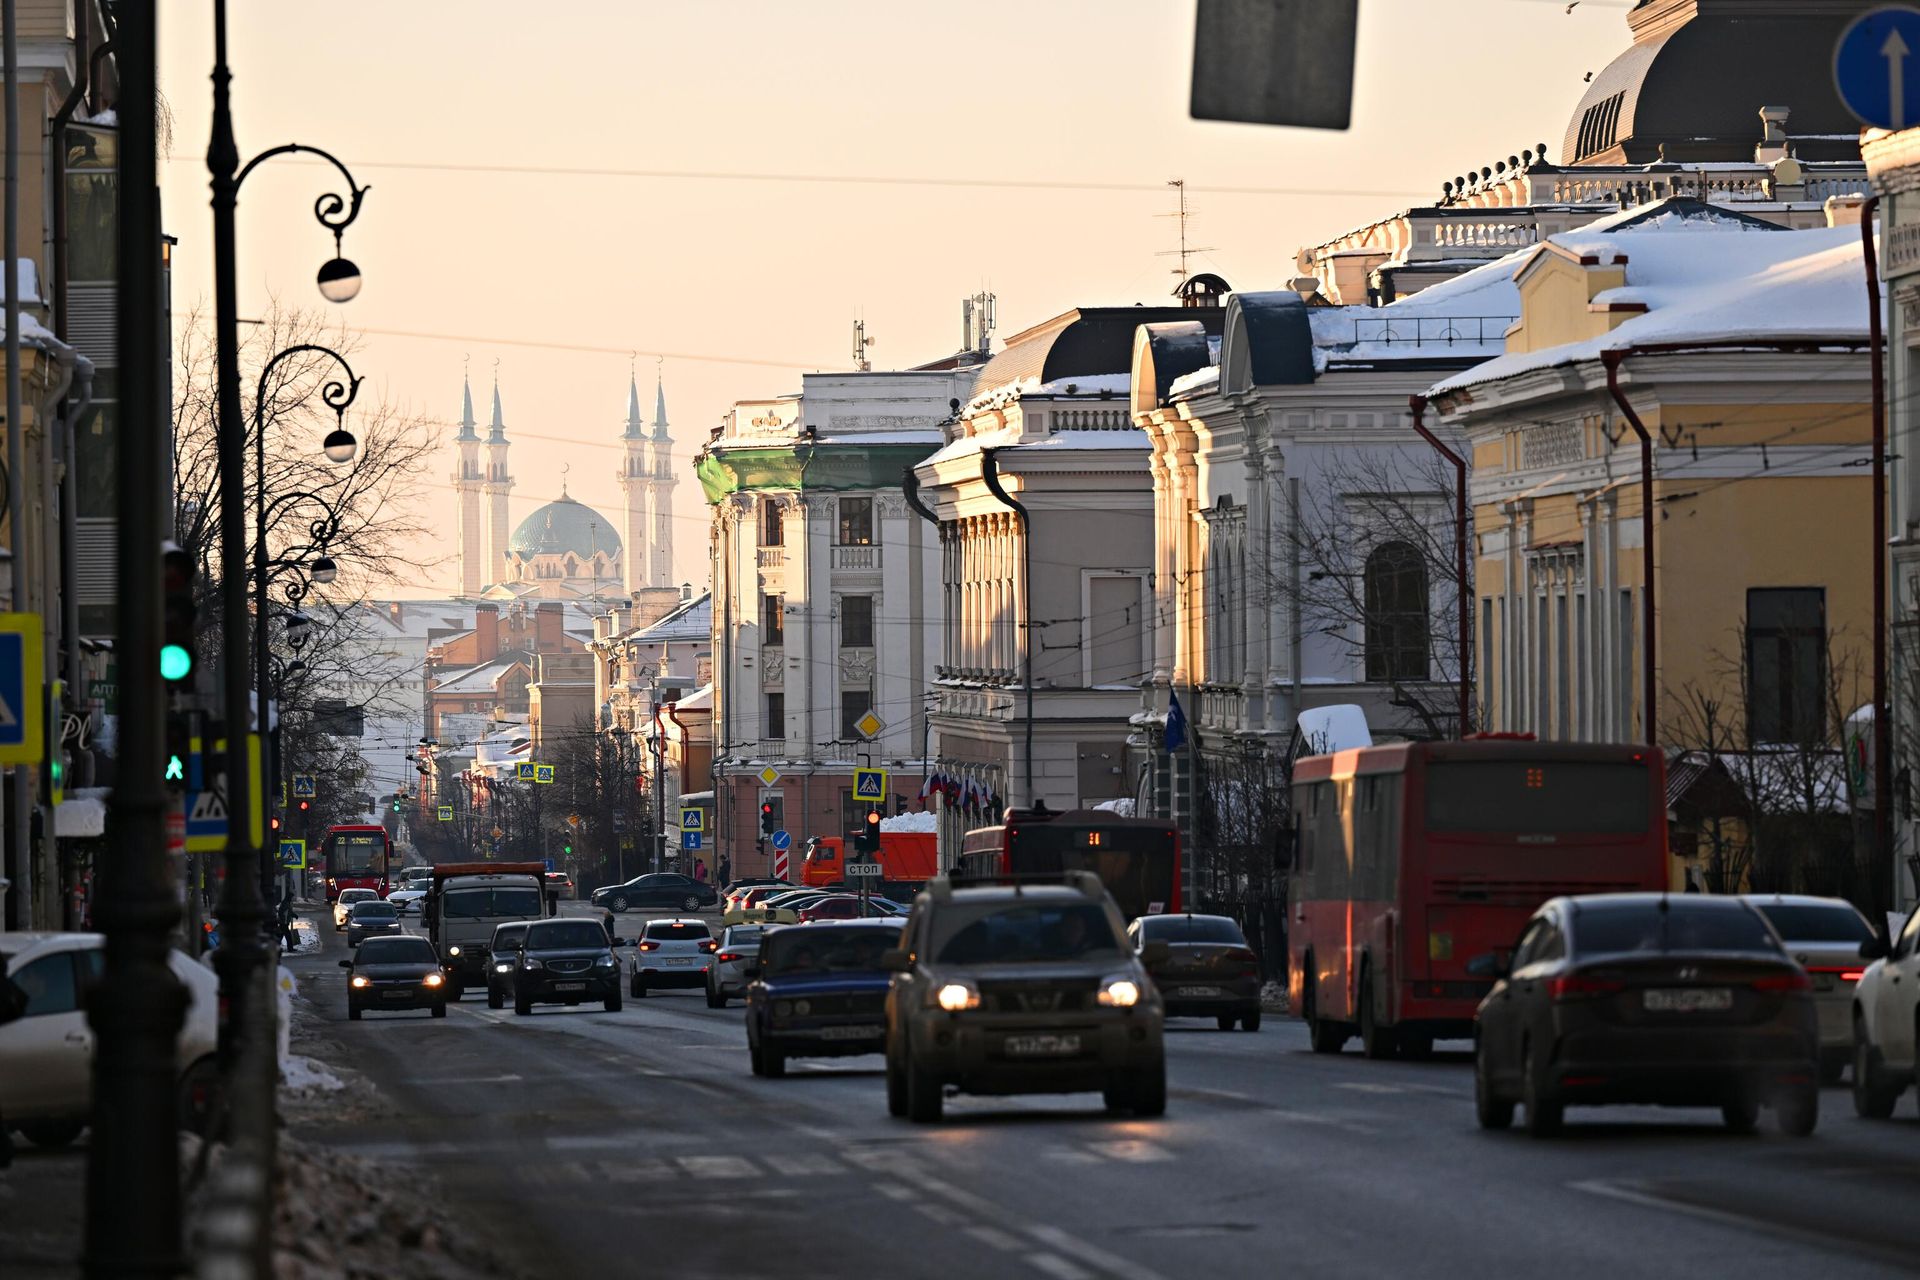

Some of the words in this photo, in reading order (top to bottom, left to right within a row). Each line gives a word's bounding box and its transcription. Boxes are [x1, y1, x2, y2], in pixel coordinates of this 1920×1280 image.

[92, 683, 119, 696] АПТ
[337, 836, 345, 844] 22
[849, 865, 878, 874] СТОП
